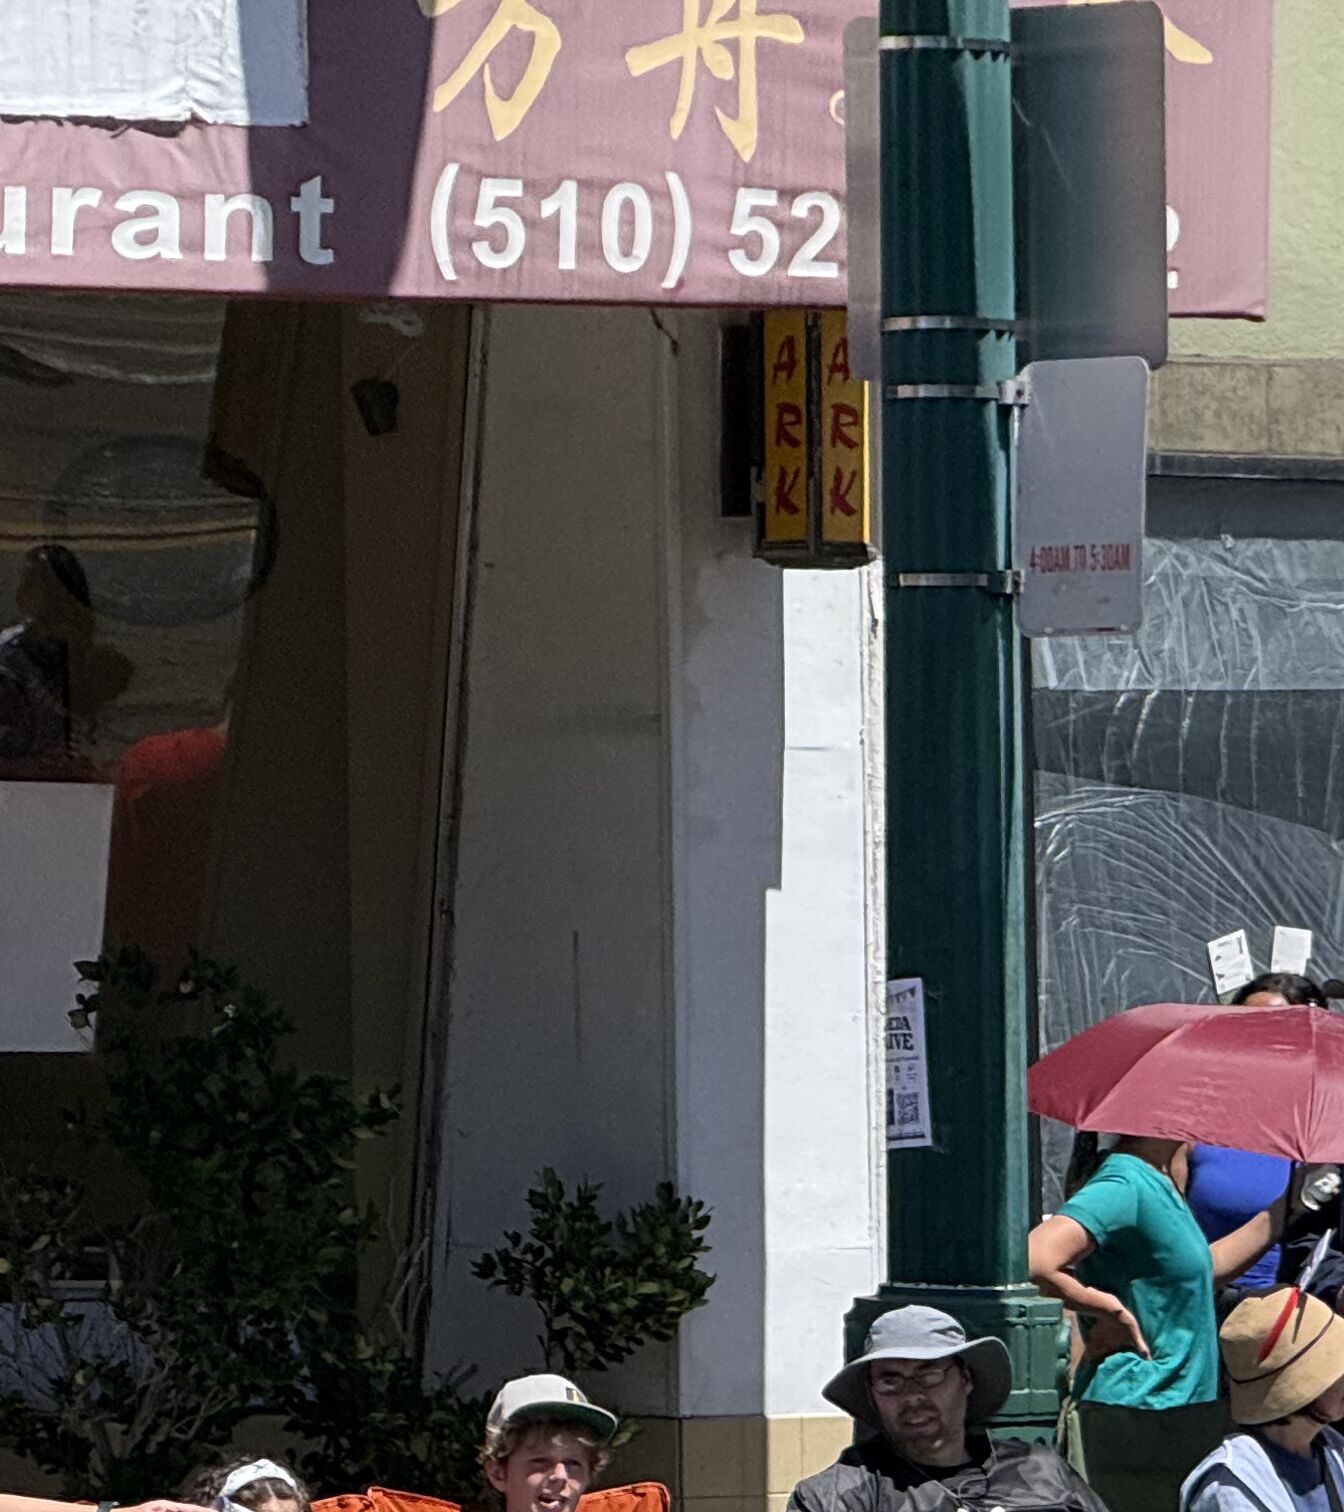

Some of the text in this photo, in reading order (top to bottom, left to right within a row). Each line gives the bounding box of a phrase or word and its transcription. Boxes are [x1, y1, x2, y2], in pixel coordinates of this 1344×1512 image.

[430, 162, 693, 290] (510)
[728, 187, 842, 278] 52
[772, 335, 802, 517] ARK
[827, 336, 859, 517] ARK
